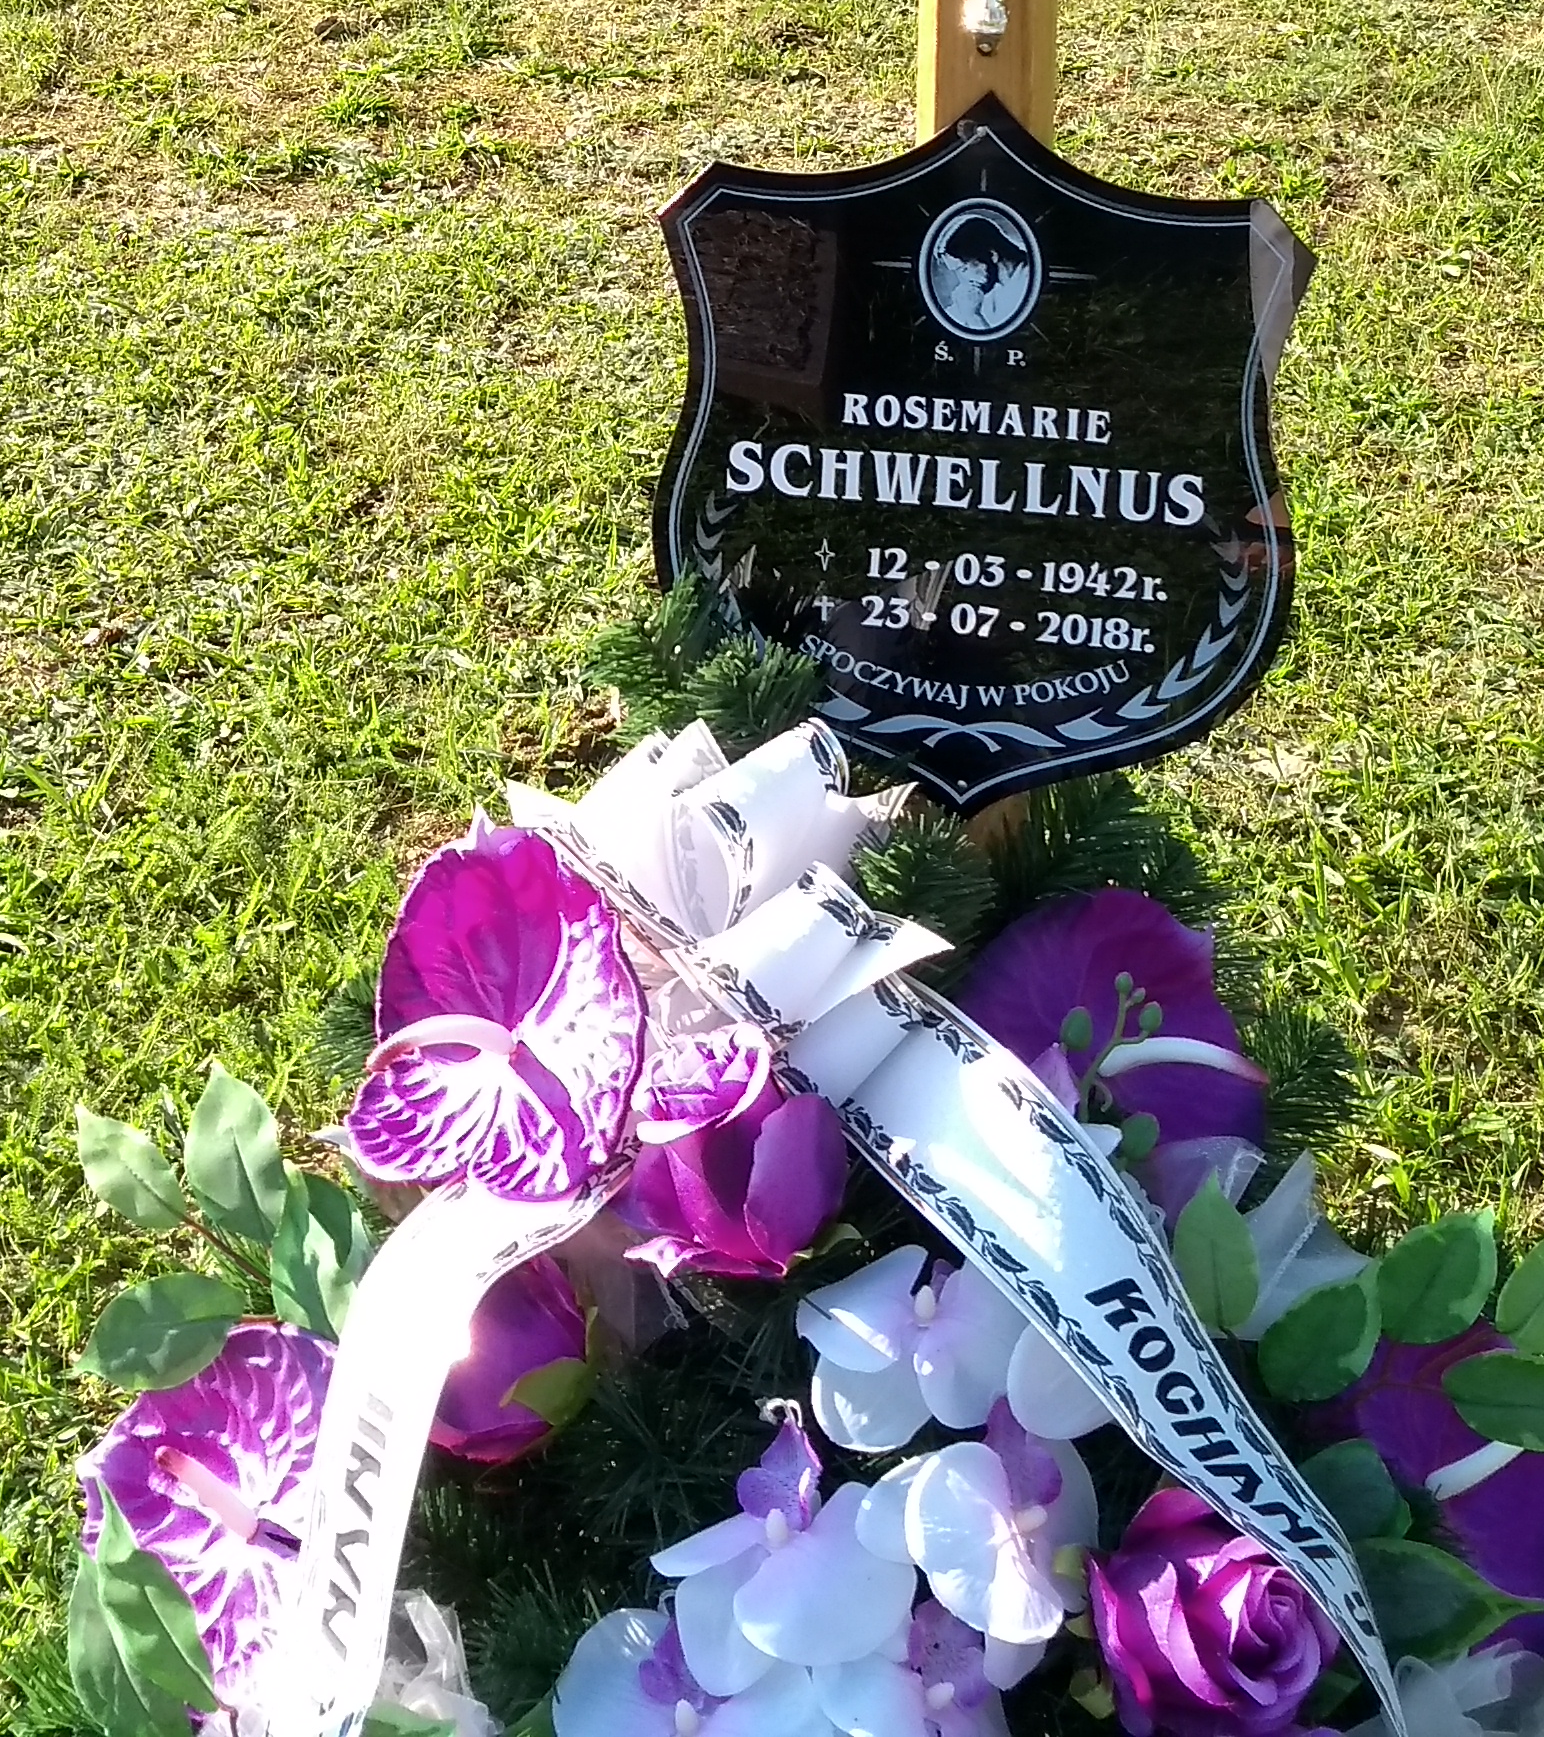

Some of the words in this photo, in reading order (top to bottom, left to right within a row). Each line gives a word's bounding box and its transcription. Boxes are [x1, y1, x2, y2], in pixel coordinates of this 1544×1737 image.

[842, 393, 1111, 444] ROSEMARIE
[726, 440, 1206, 527] SCHWELLNUS
[799, 634, 970, 710] SPOCZYWAJ
[979, 686, 1007, 707] W
[1014, 660, 1131, 706] POKOJU
